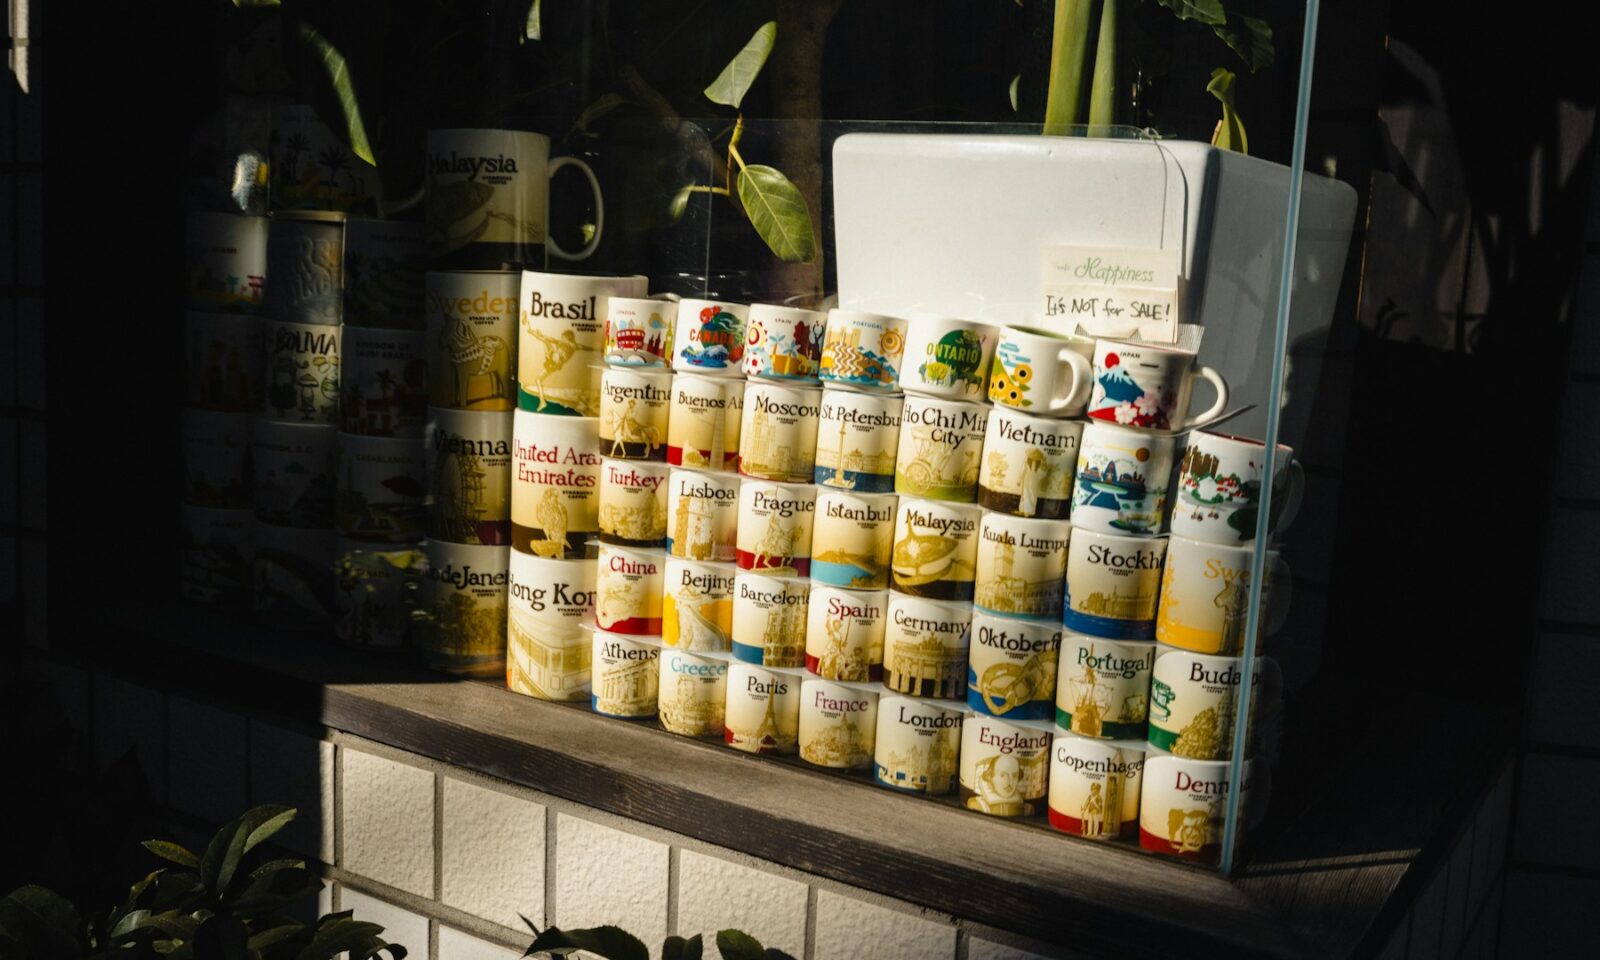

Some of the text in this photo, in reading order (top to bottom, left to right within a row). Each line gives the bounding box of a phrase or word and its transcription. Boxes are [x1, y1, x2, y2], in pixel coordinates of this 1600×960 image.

[1074, 257, 1154, 285] Happiness
[531, 291, 596, 321] Brasil
[1045, 295, 1170, 322] It's NOT for SALE!
[690, 328, 735, 345] CANADA
[853, 321, 883, 331] PORTUGAL
[927, 342, 979, 364] ONTARIO
[1120, 351, 1141, 359] JAPAN
[679, 391, 726, 409] Buenos
[754, 395, 820, 418] Moscow
[822, 404, 834, 421] St.
[904, 404, 920, 424] Ho
[922, 407, 957, 430] Chi
[931, 428, 966, 450] City
[1000, 418, 1076, 450] Vietnam
[514, 438, 559, 464] United
[518, 462, 596, 488] Emirates
[609, 466, 665, 494] Turkey
[681, 480, 737, 501] Lisboa
[753, 491, 816, 518] Prague
[827, 500, 892, 522] Istanbul
[905, 508, 976, 536] Malaysia
[983, 525, 1016, 547] Kuala
[610, 556, 658, 576] China
[682, 569, 736, 595] Beijing
[828, 596, 880, 621] Spain
[895, 608, 971, 640] Germany
[601, 641, 659, 662] Athens
[1077, 647, 1150, 679] Portugal
[671, 656, 728, 677] Greece
[747, 676, 788, 696] Paris
[815, 691, 869, 712] France
[898, 706, 963, 730] London
[979, 727, 1049, 755] England
